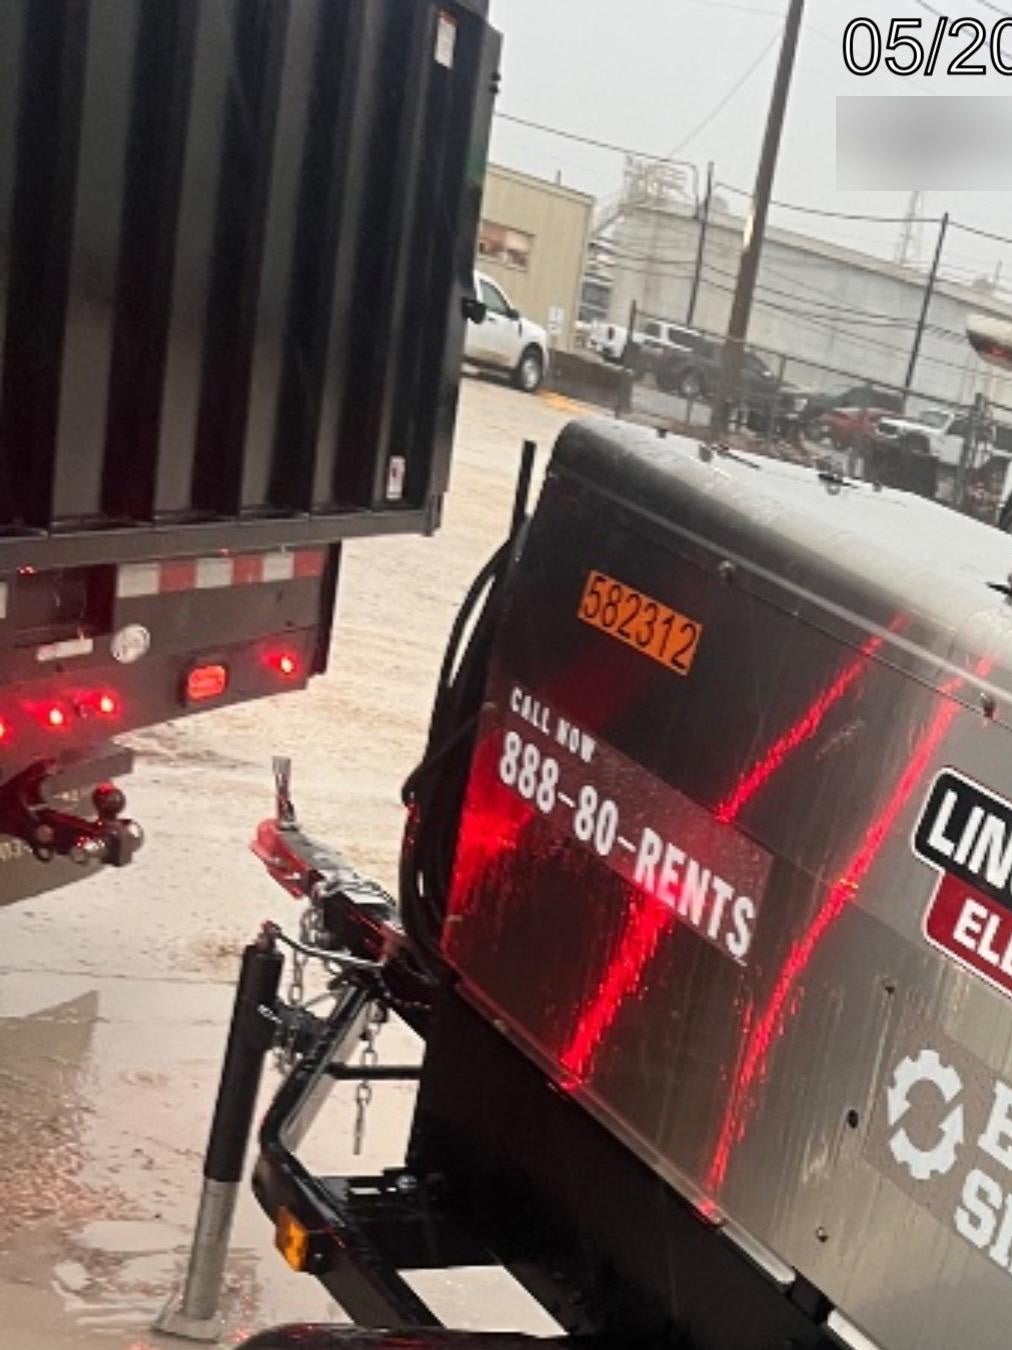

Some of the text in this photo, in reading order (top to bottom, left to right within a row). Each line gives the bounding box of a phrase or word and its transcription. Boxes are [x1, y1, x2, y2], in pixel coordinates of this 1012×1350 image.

[583, 576, 699, 671] 582312
[510, 686, 599, 763] CALL NOW
[498, 730, 758, 961] 888-80-RENTS
